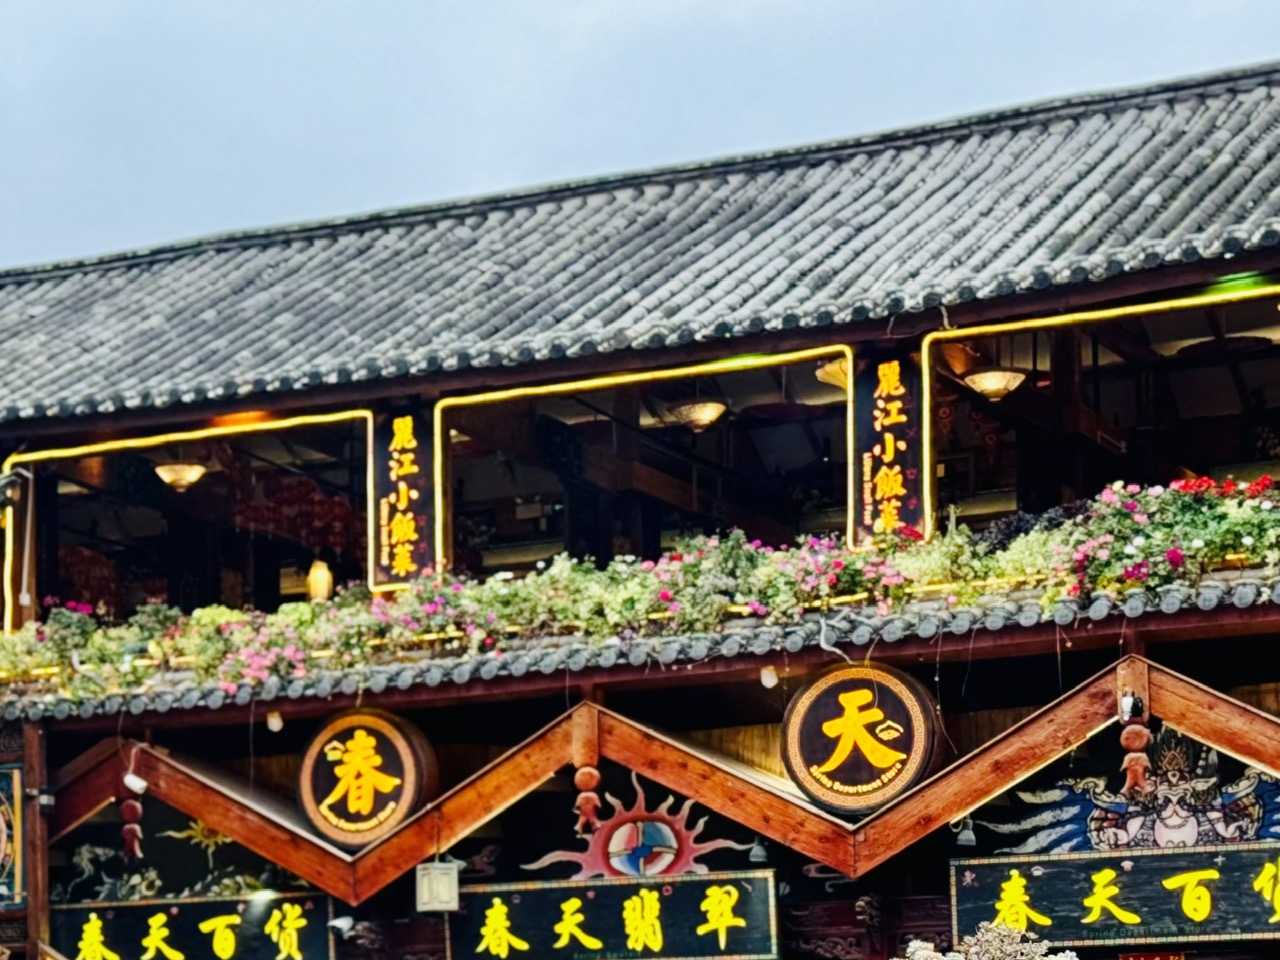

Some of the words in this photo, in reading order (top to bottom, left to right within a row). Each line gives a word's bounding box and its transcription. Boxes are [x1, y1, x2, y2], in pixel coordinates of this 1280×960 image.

[321, 729, 402, 815] 春
[817, 688, 908, 773] 天
[474, 884, 747, 960] 春天翡翠
